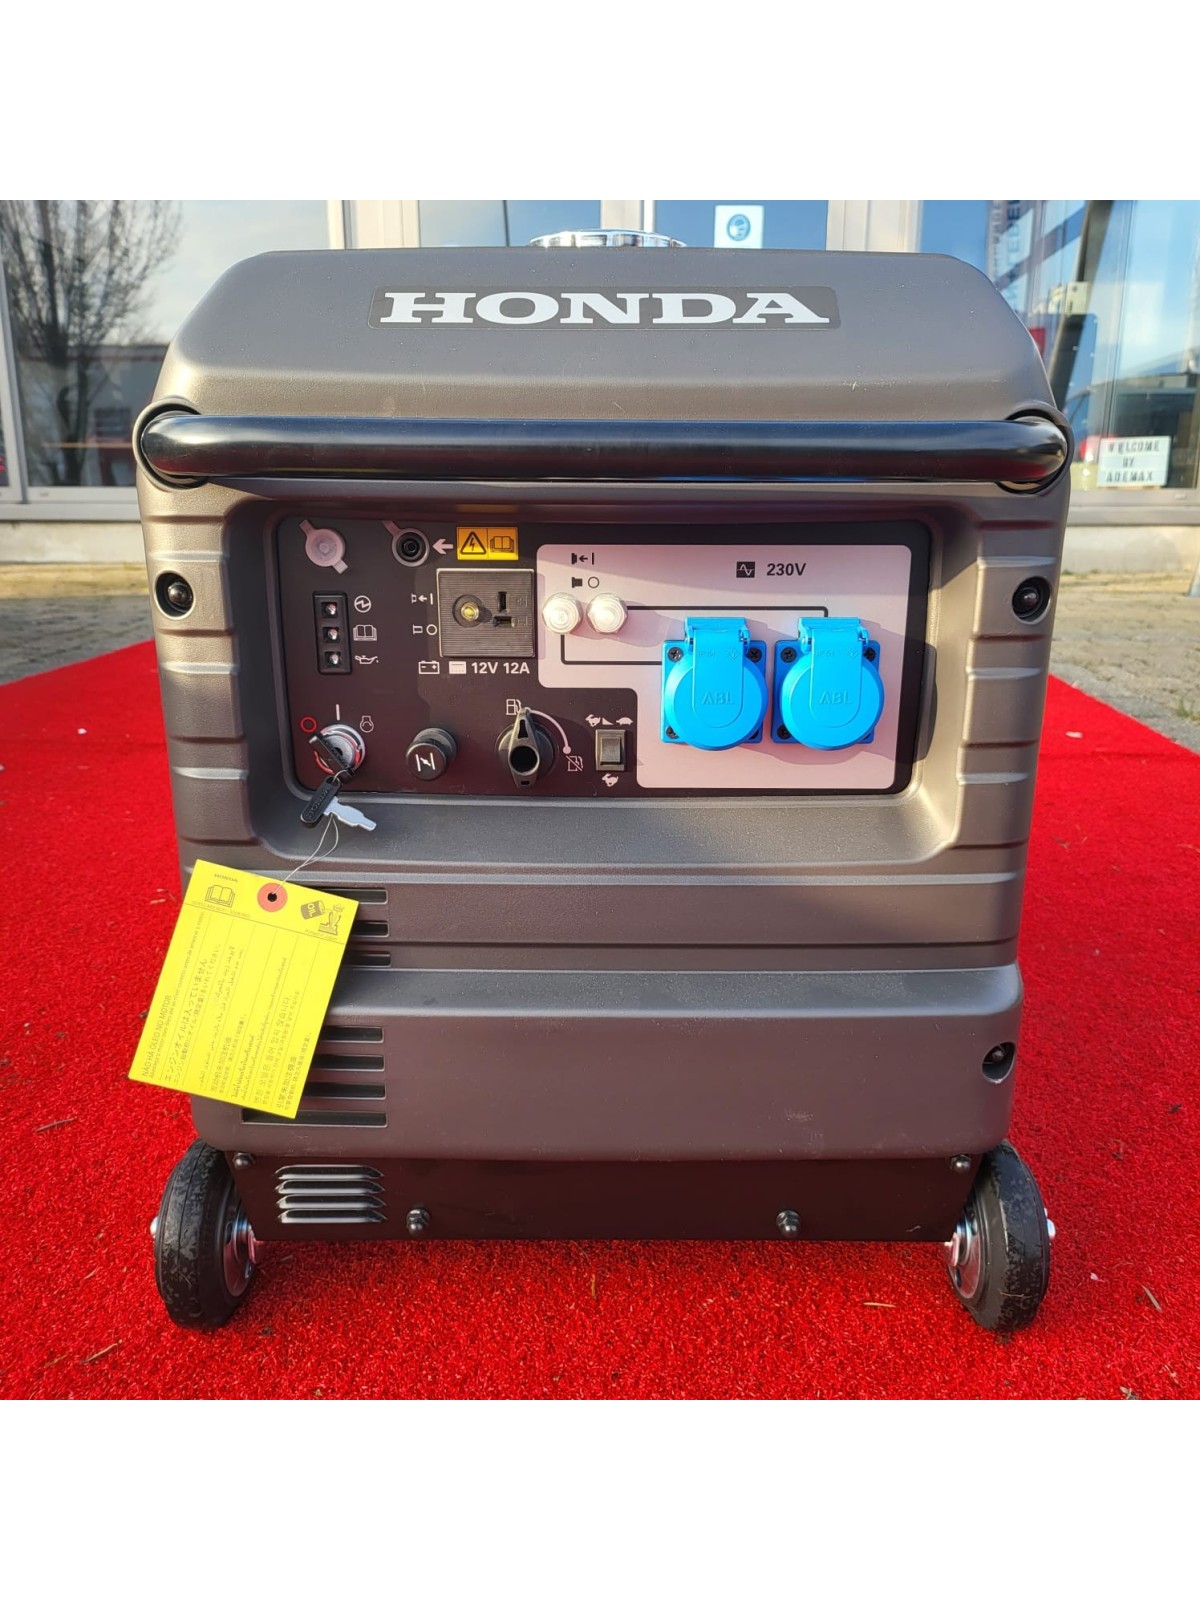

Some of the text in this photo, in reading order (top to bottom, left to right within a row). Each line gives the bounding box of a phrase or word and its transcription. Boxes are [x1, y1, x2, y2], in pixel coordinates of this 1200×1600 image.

[379, 291, 831, 324] HONDA
[1108, 440, 1160, 454] WELCOME
[1122, 456, 1135, 468] BY
[766, 563, 806, 576] 230V
[471, 661, 531, 675] 12V 12A
[701, 691, 735, 705] ABL
[818, 691, 853, 705] ABL
[307, 903, 317, 918] OIL
[140, 1060, 151, 1076] NÃO
